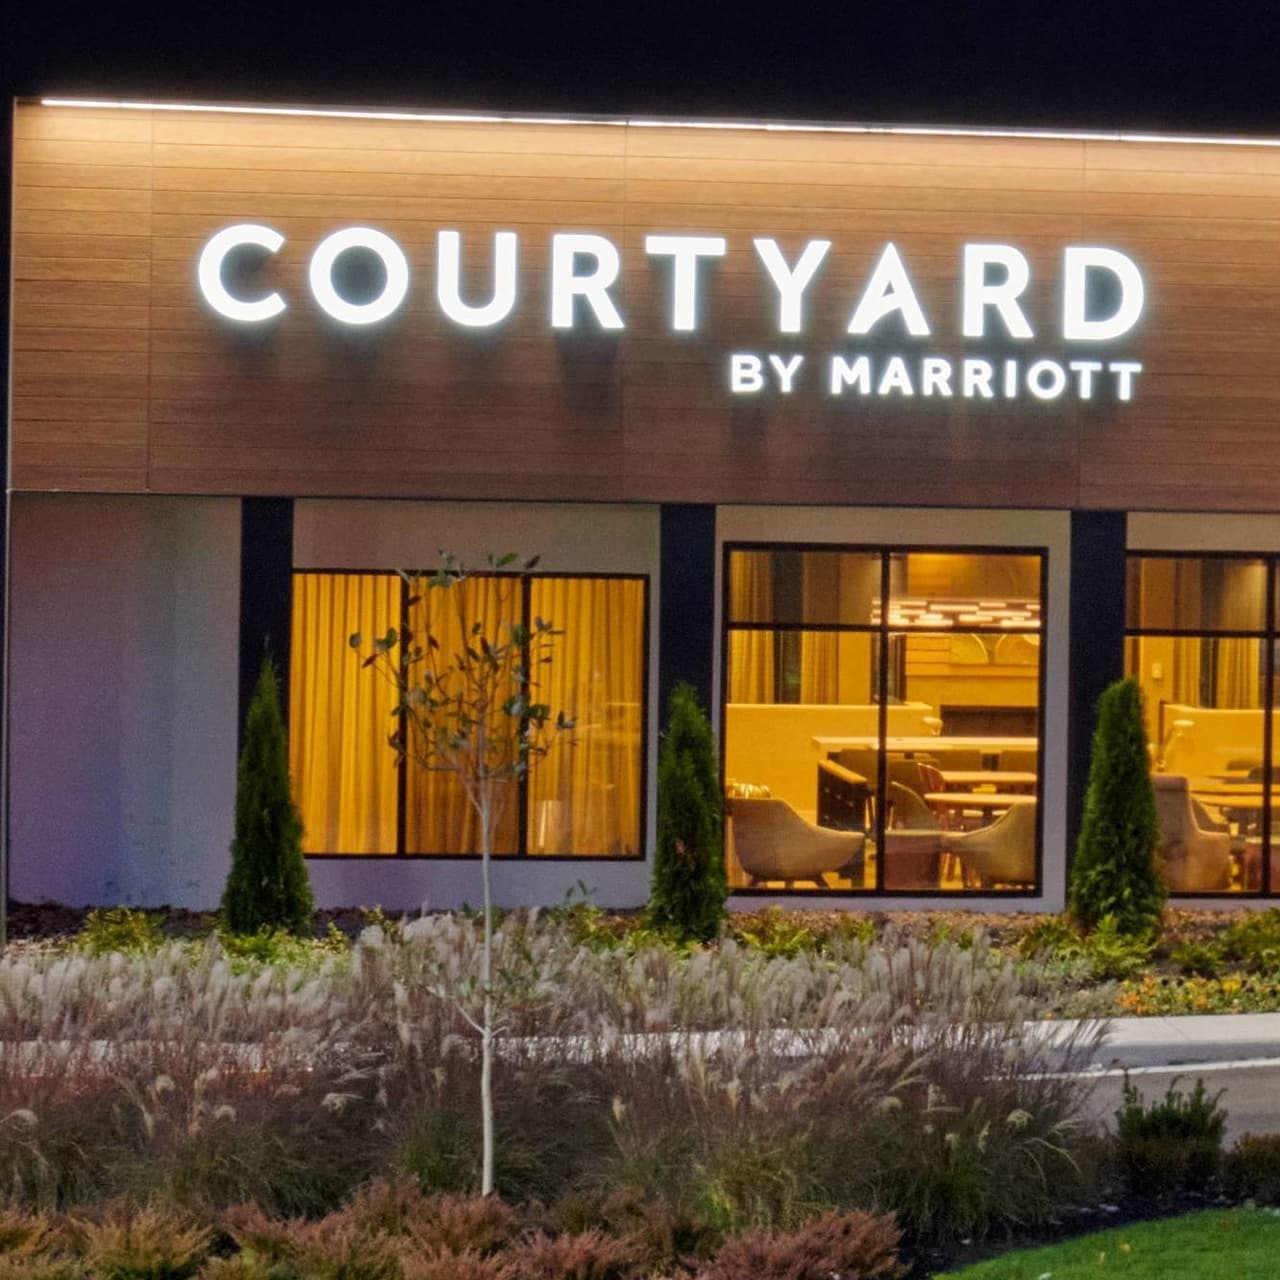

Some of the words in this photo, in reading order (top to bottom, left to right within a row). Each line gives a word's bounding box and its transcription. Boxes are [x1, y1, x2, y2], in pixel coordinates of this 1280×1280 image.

[198, 223, 1145, 341] COURTYARD
[730, 354, 804, 393] BY
[830, 356, 1144, 401] MARRIOTT
